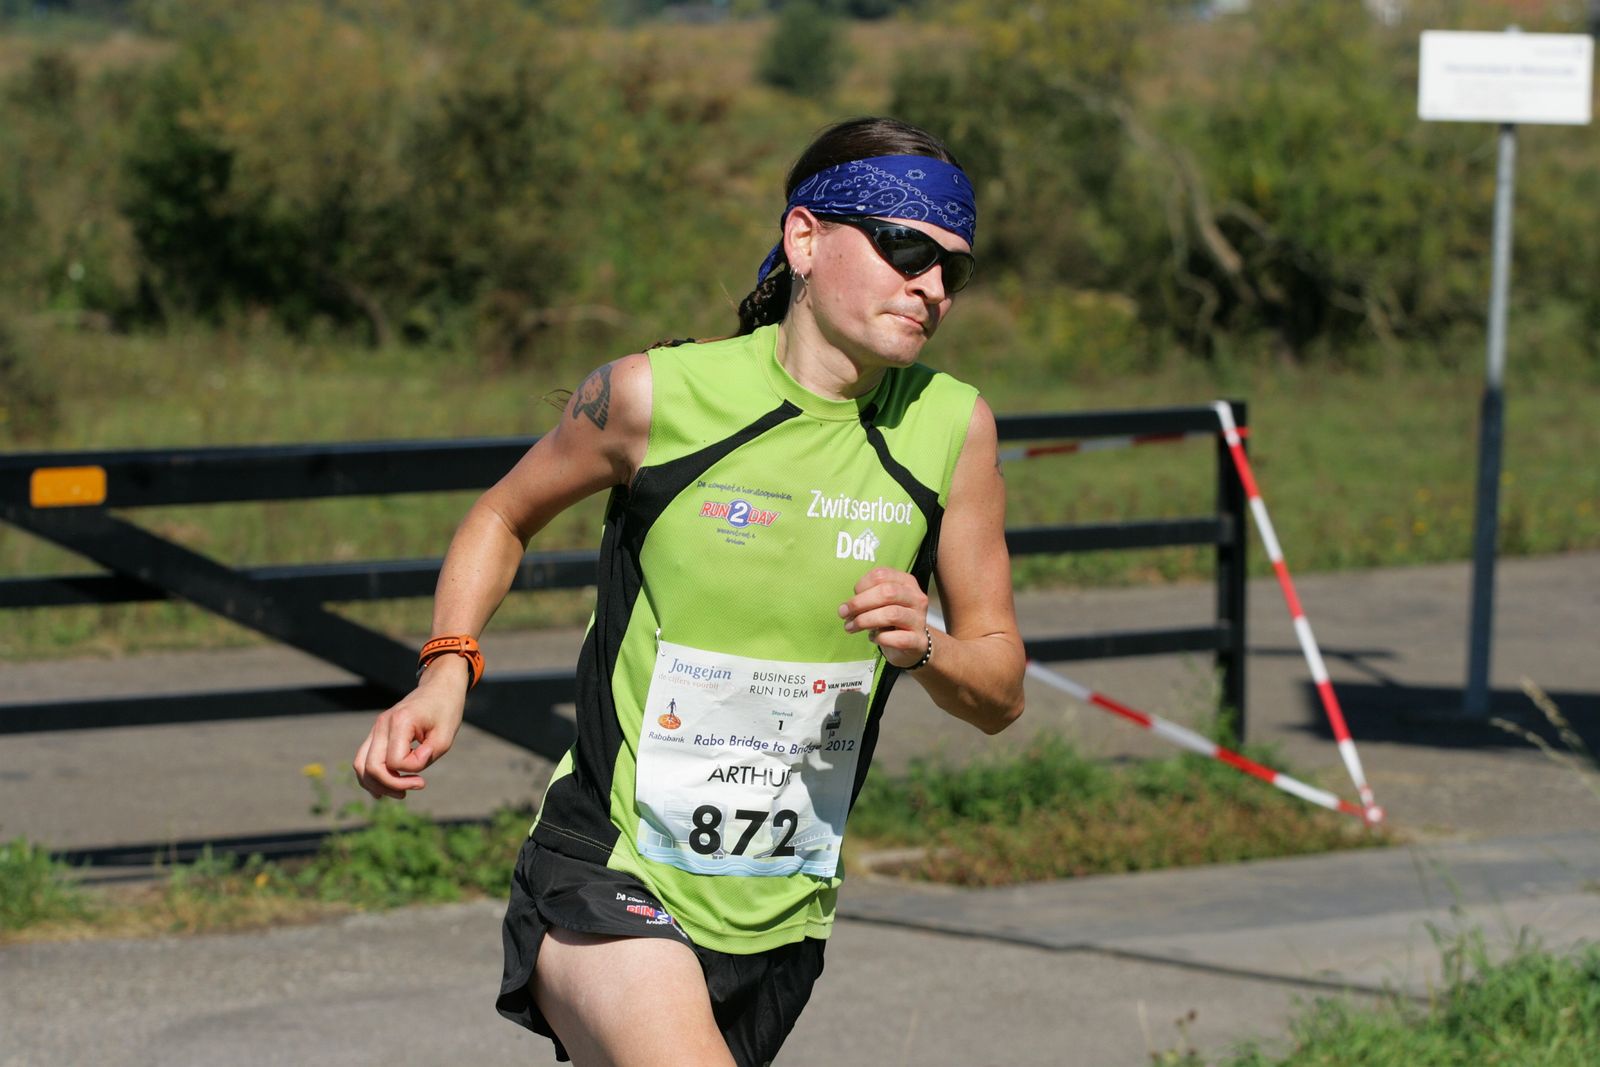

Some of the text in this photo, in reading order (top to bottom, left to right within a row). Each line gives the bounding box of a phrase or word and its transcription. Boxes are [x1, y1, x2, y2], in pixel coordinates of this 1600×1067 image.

[806, 489, 914, 525] Zwitserloot
[836, 530, 877, 562] Dak
[668, 658, 732, 681] Jongejan
[752, 671, 806, 685] BUSINESS
[749, 685, 808, 698] RUN 10 EM
[828, 681, 839, 690] VAN
[778, 720, 784, 731] 1
[648, 731, 685, 744] Rabobank
[693, 734, 855, 755] Rabo Bridge to Bridge 2012
[688, 804, 799, 857] 872
